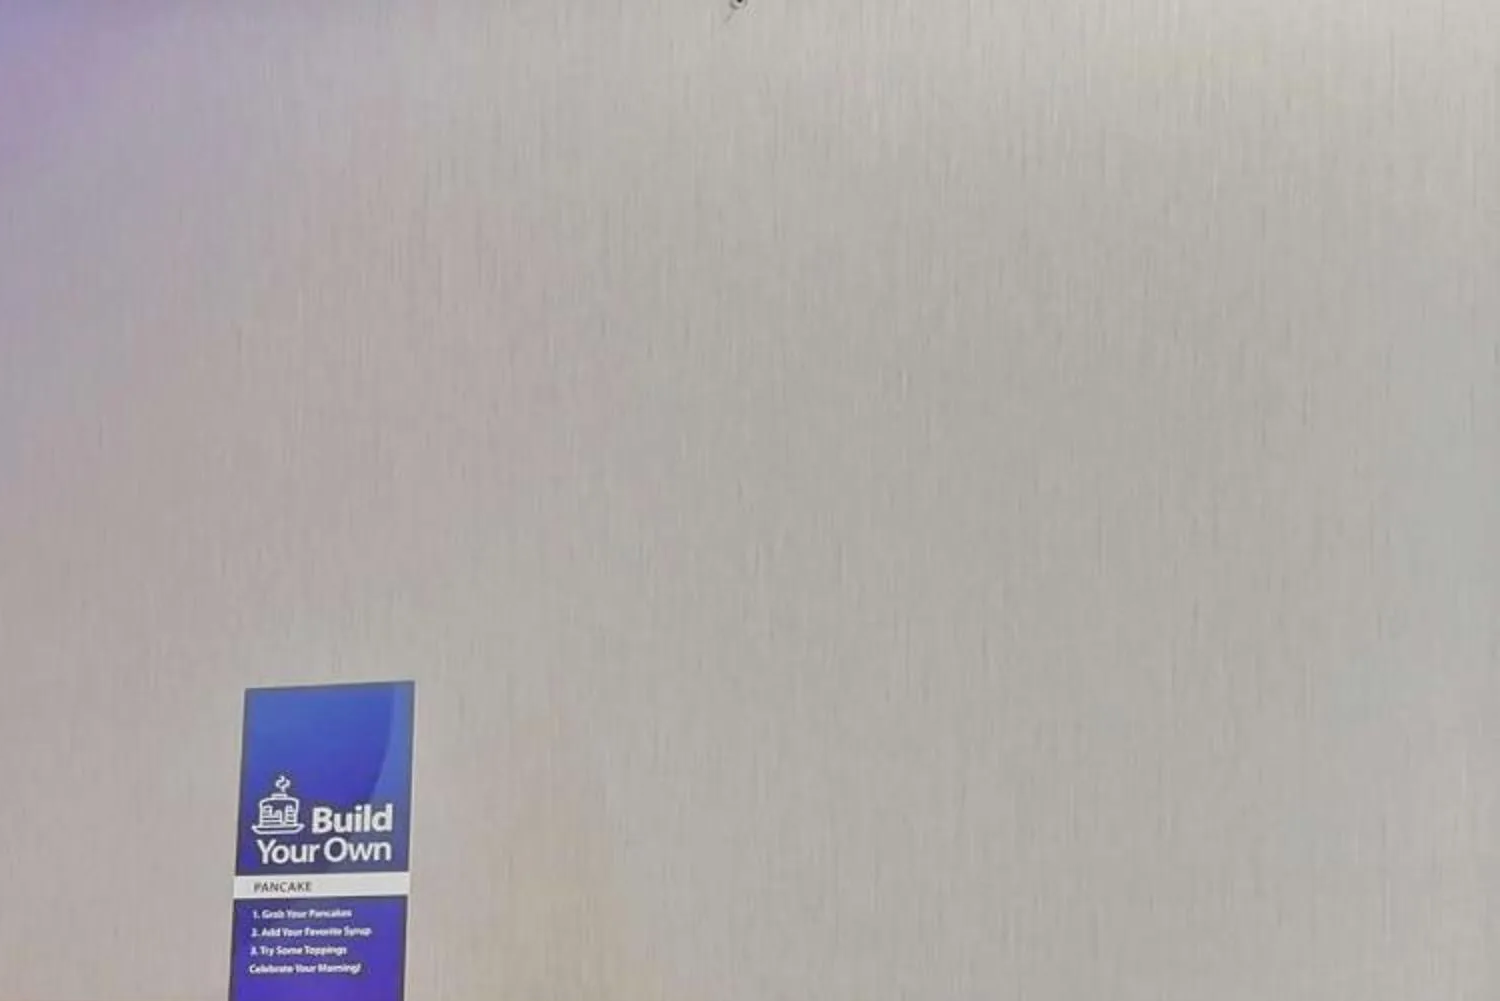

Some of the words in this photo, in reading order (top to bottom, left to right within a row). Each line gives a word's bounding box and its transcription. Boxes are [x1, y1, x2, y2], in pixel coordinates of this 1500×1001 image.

[312, 803, 392, 833] Build
[257, 838, 320, 864] Your
[323, 836, 392, 862] Own
[254, 882, 312, 893] PANCAKE
[261, 909, 285, 919] Grab
[286, 909, 307, 919] Your
[261, 928, 281, 937] Add
[282, 928, 303, 937] Your
[304, 927, 342, 937] Favorite
[259, 946, 275, 956] Try
[276, 946, 303, 956] Some
[304, 945, 348, 957] Toppings
[249, 964, 295, 974] Celebrate
[295, 964, 317, 974] Your
